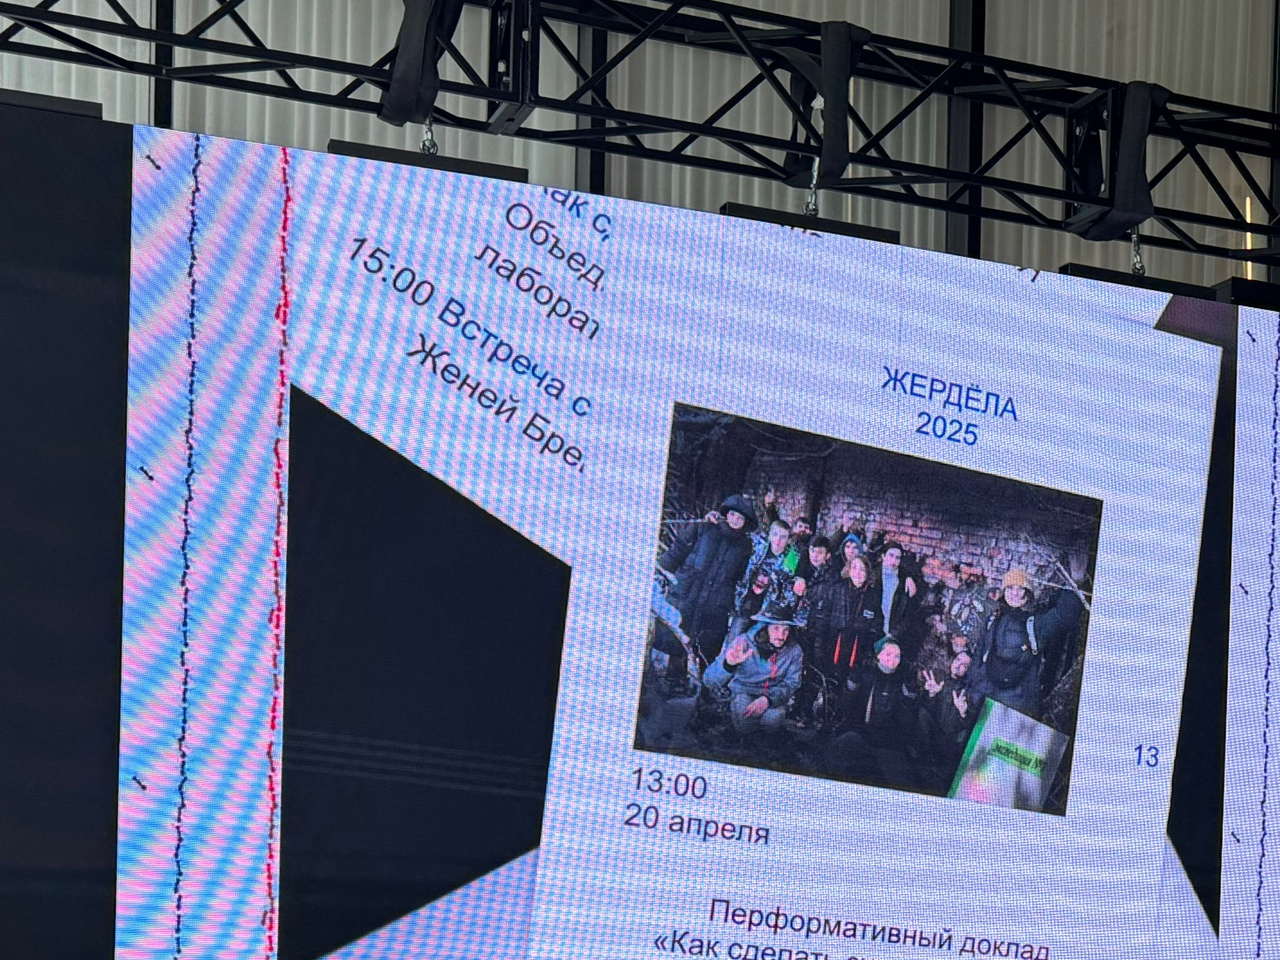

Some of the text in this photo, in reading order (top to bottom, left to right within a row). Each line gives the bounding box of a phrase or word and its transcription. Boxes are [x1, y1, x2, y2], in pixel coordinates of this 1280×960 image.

[543, 187, 590, 219] ак
[505, 202, 606, 293] Объед
[349, 236, 592, 418] 15:00 Встреча с
[406, 332, 586, 474] Женей Бре
[881, 365, 1018, 422] ЖЕРДЁЛА
[915, 410, 979, 447] 2025
[1134, 743, 1160, 768] 13
[632, 767, 708, 800] 13:00
[624, 802, 770, 846] 20 апреля
[653, 929, 721, 958] «Как
[708, 897, 953, 953] Перформативный
